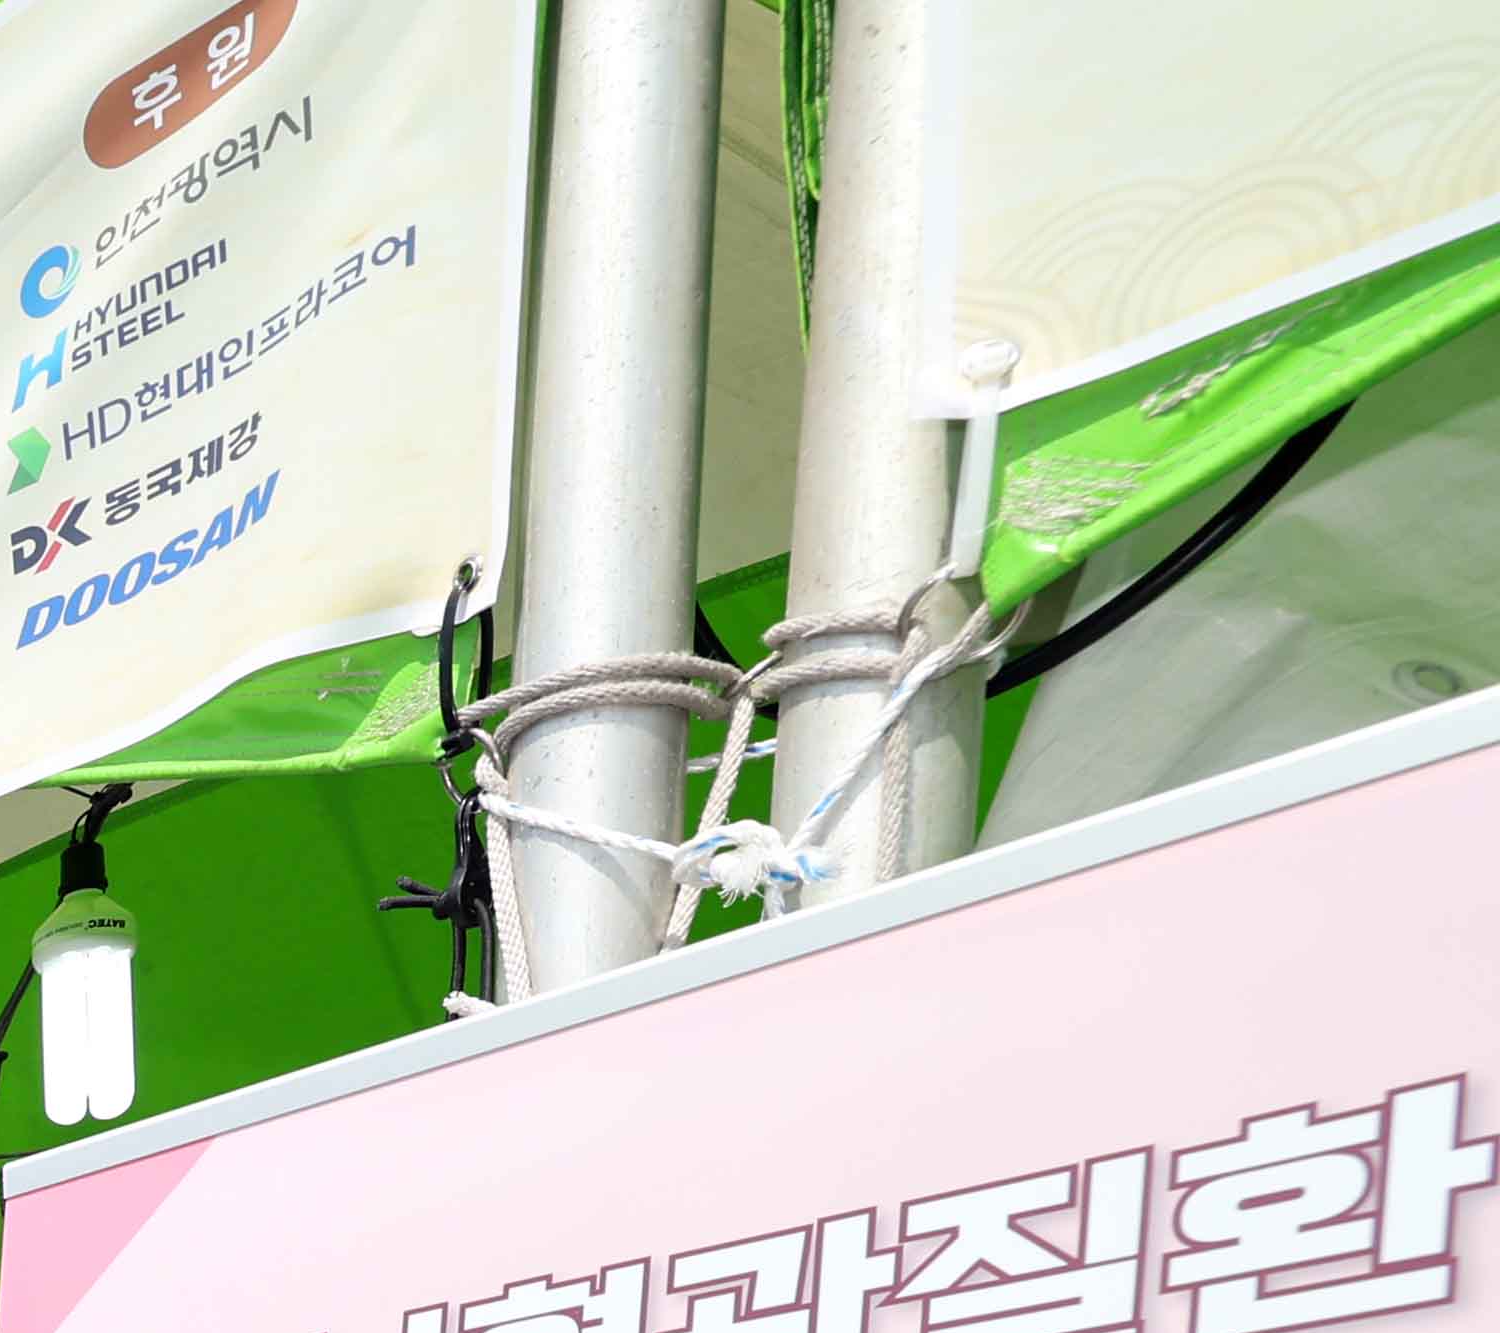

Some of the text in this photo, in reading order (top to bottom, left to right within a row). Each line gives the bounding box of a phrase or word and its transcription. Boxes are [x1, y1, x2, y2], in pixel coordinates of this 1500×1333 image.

[131, 11, 254, 133] 후원
[94, 97, 313, 269] 인천광역시
[70, 304, 185, 372] STEEL
[73, 239, 228, 336] HYUNDAI
[104, 412, 262, 527] 동국제강
[15, 470, 281, 651] DOOSAN
